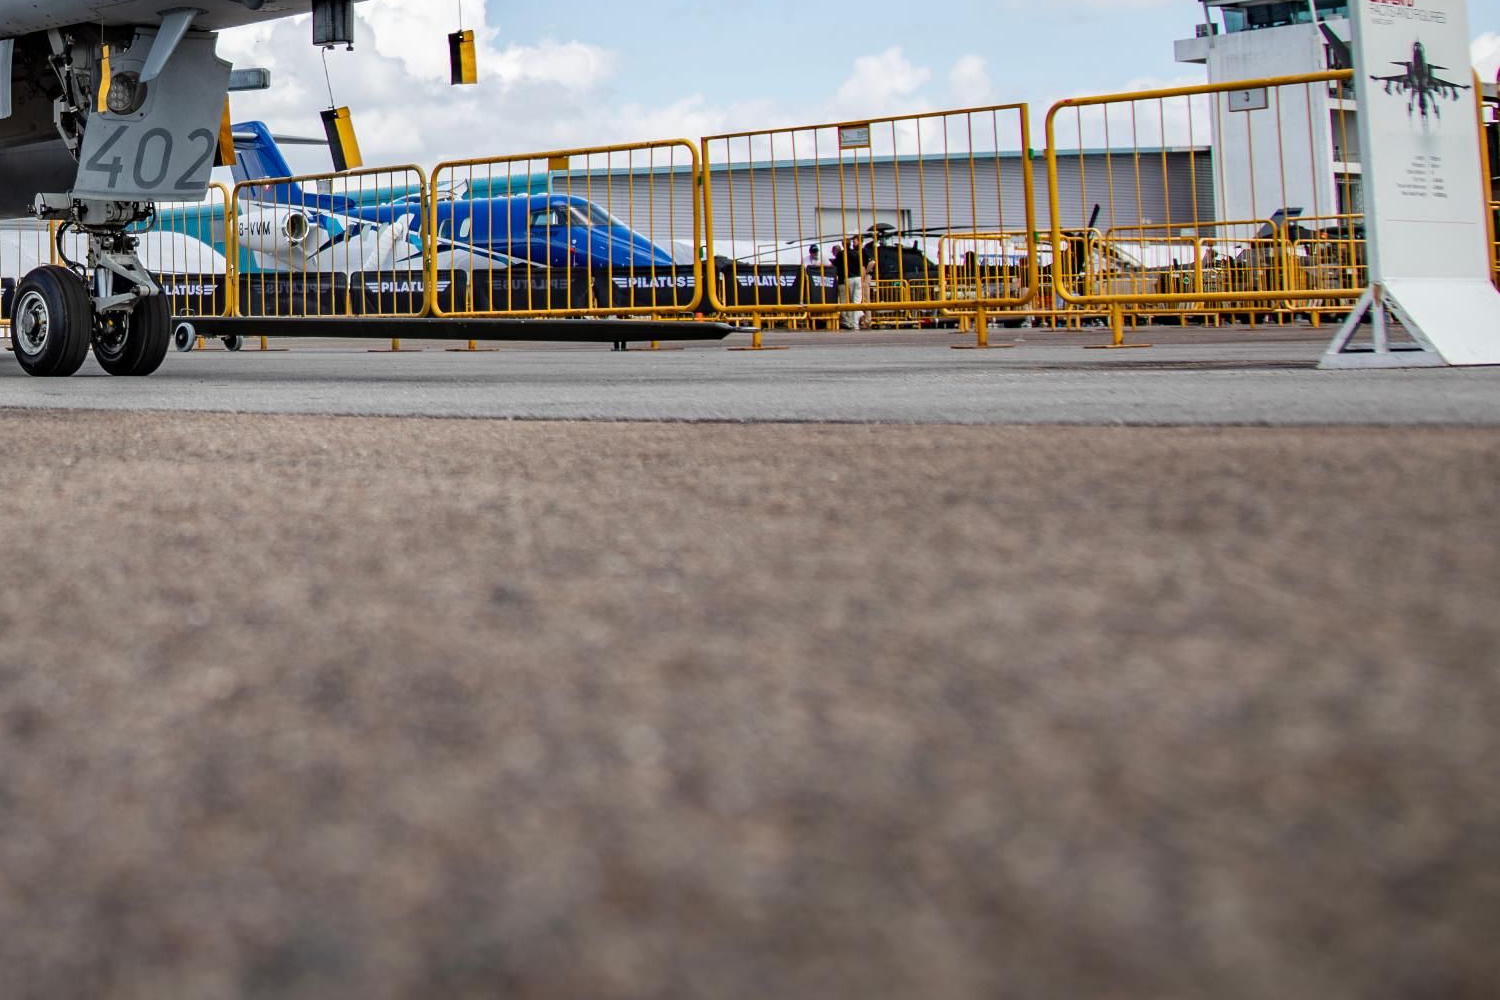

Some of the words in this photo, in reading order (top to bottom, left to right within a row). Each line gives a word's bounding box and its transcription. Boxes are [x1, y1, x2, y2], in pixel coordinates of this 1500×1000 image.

[85, 125, 215, 190] 402
[381, 281, 431, 293] PILATU
[628, 277, 686, 288] PILATUS
[748, 275, 786, 287] PILATUS
